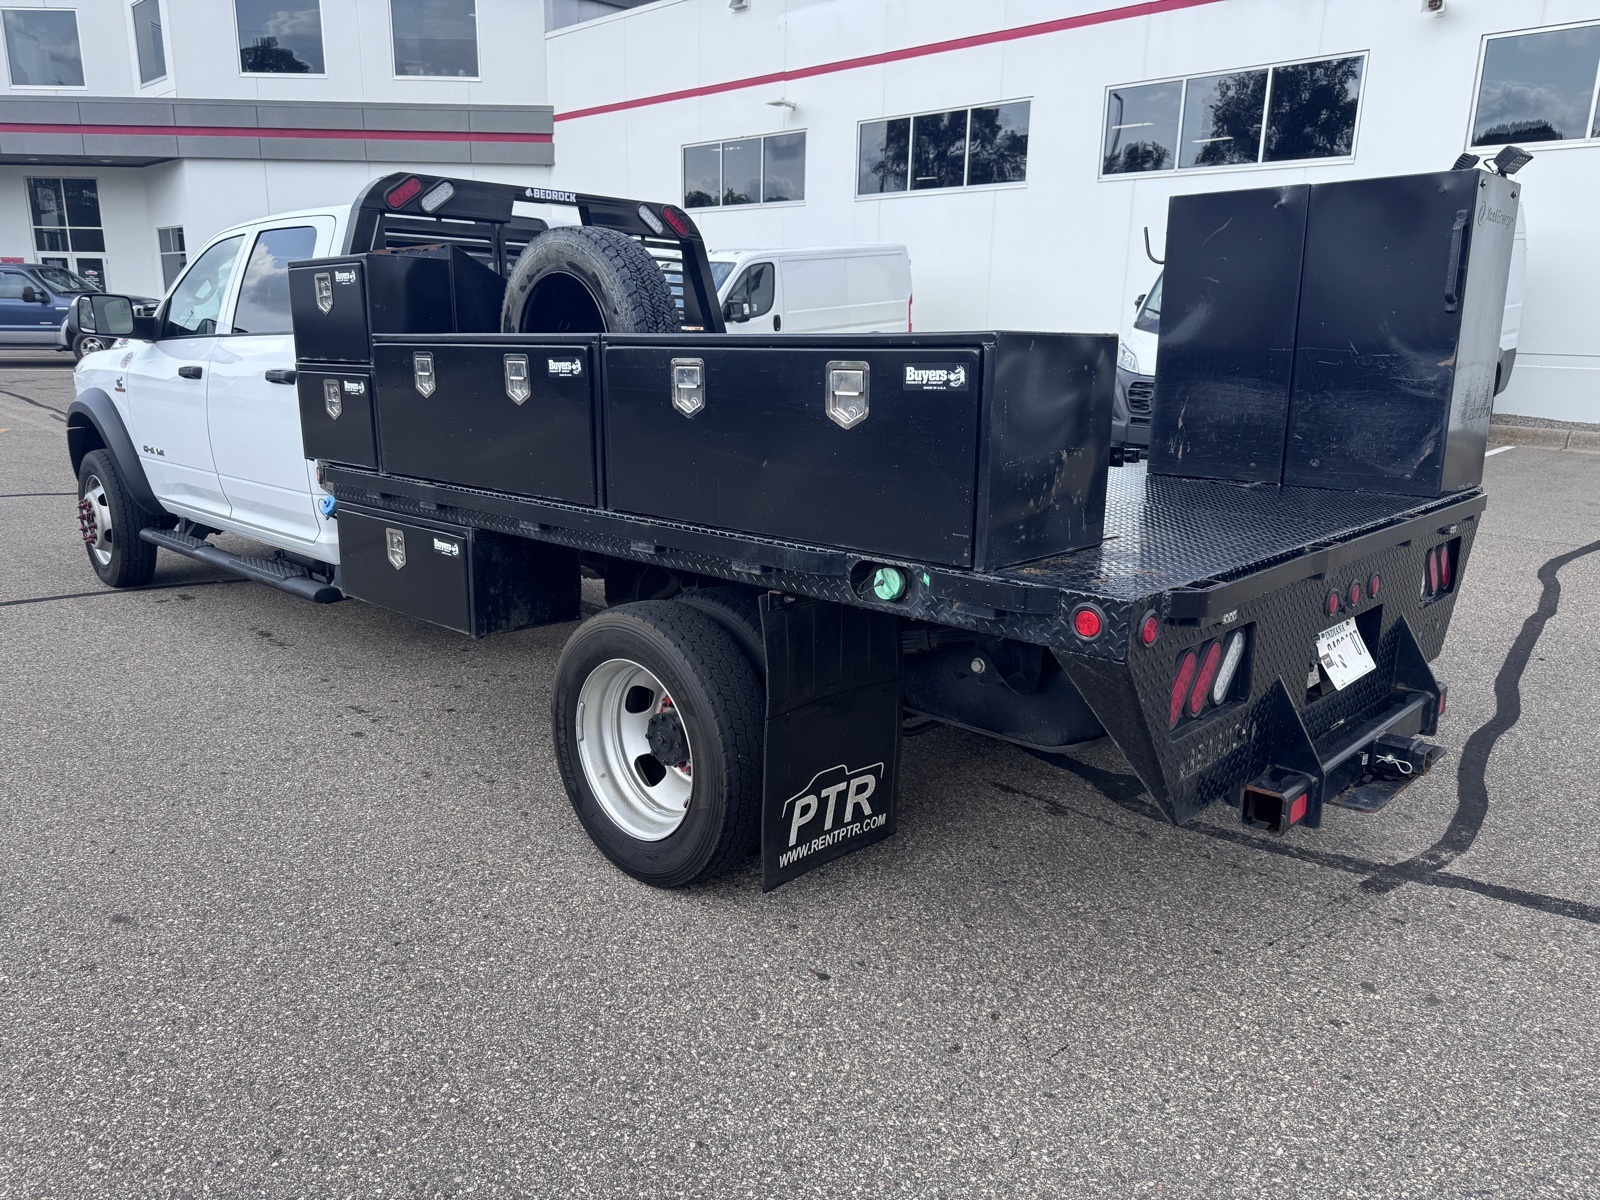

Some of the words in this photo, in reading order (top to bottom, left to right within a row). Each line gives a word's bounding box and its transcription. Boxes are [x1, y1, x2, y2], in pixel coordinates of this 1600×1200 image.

[534, 189, 576, 202] BEDROCK
[549, 360, 571, 372] Buyers
[906, 367, 947, 384] Buyers
[1325, 624, 1346, 640] INDIANA
[789, 775, 876, 847] PTR
[779, 813, 887, 869] WWW.RENTPTR.COM
